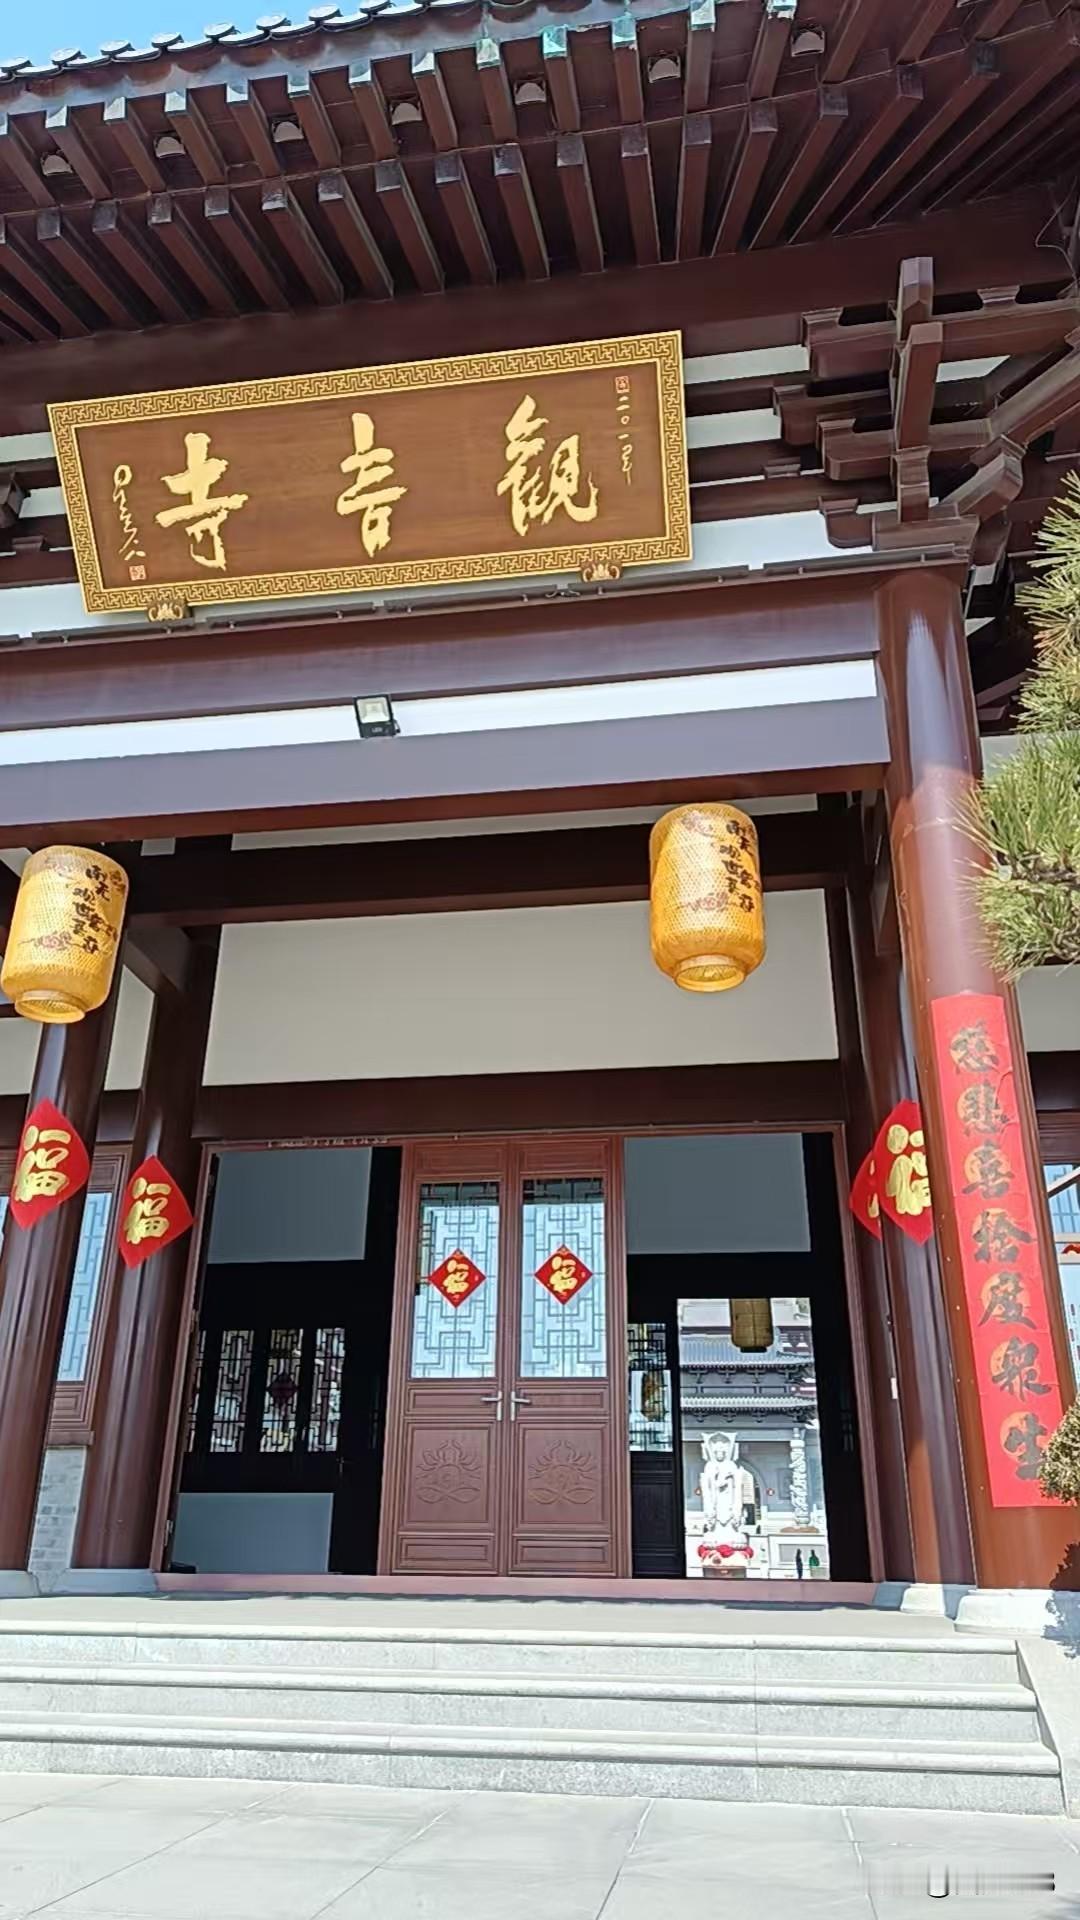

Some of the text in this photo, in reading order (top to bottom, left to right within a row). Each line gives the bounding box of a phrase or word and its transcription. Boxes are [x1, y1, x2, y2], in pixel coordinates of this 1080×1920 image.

[154, 394, 600, 570] 觀音寺
[14, 1124, 72, 1203] 福
[123, 1176, 172, 1245] 福
[443, 1259, 470, 1294] 福
[549, 1256, 578, 1293] 福
